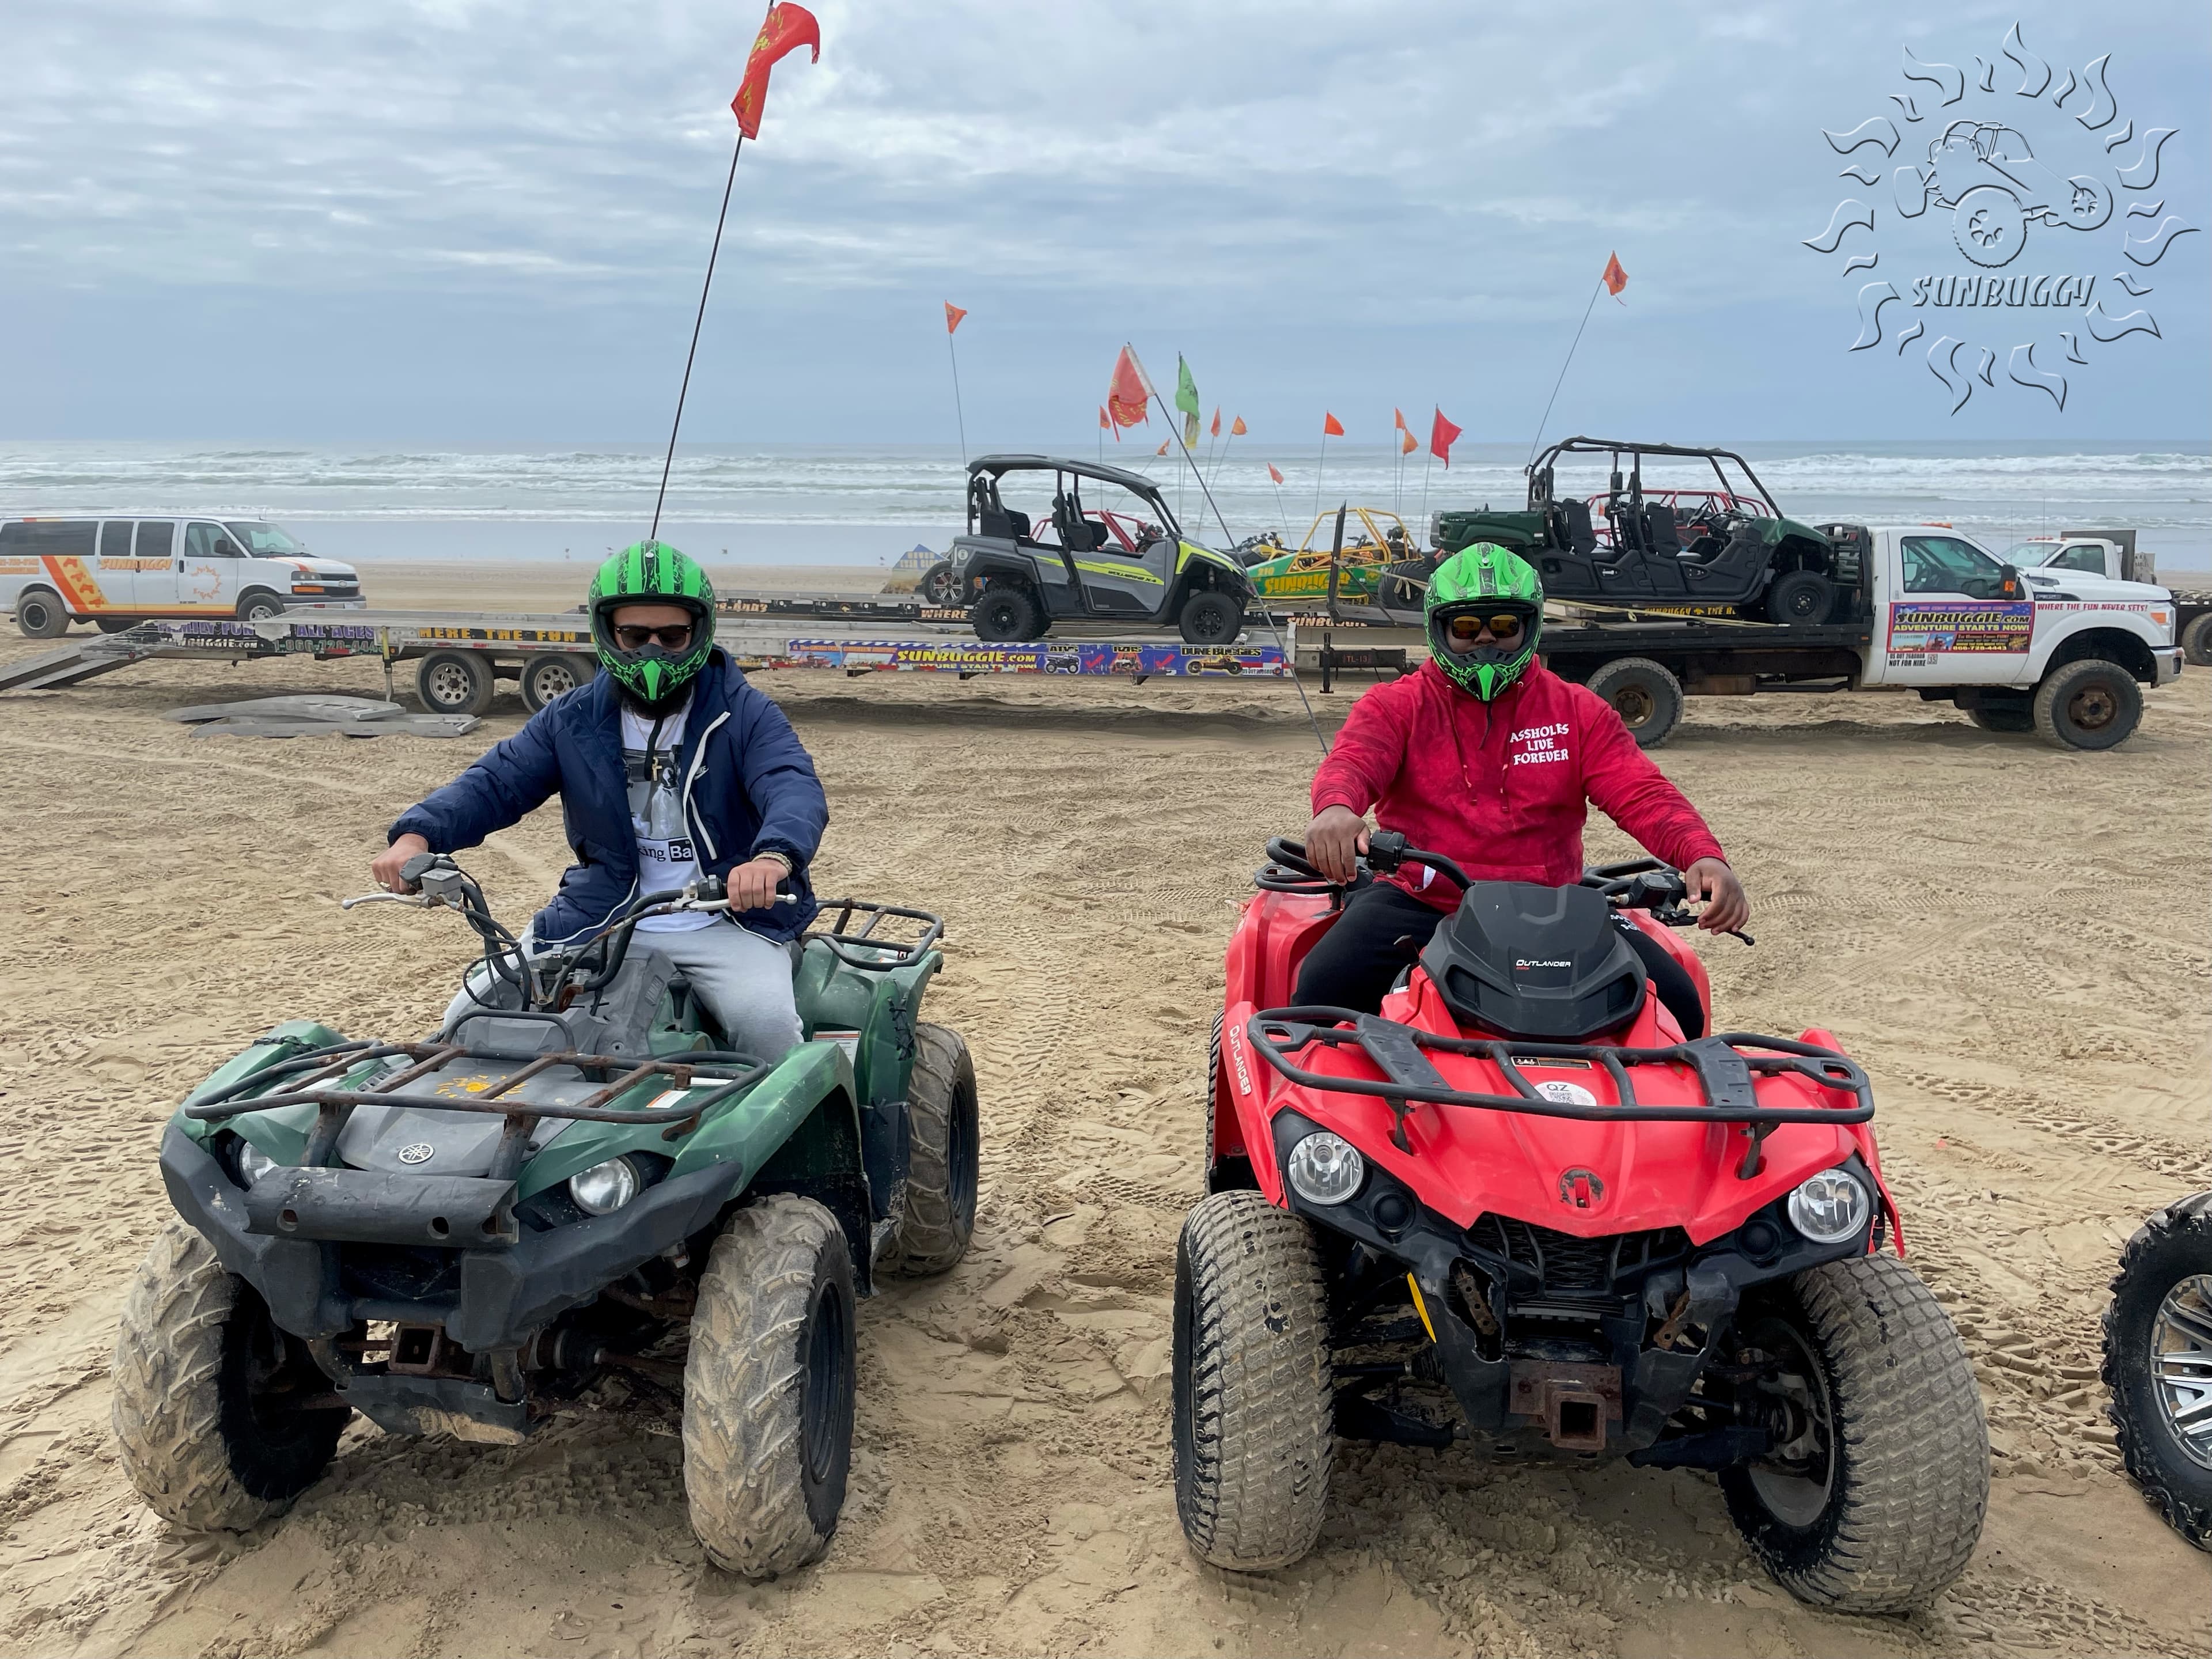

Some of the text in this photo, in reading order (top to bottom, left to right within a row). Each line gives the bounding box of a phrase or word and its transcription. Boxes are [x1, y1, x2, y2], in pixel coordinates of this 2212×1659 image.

[922, 609, 969, 619] WHERE
[2128, 604, 2149, 612] SETS!
[296, 624, 326, 638] ALL
[484, 628, 522, 641] THE
[536, 630, 576, 642] FUN
[1509, 723, 1569, 743] ASSHOLES
[1527, 738, 1554, 751] LIVE
[1513, 748, 1569, 766] FOREVER
[1516, 959, 1571, 967] OUTLANDER
[1229, 1024, 1253, 1096] OUTLANDER
